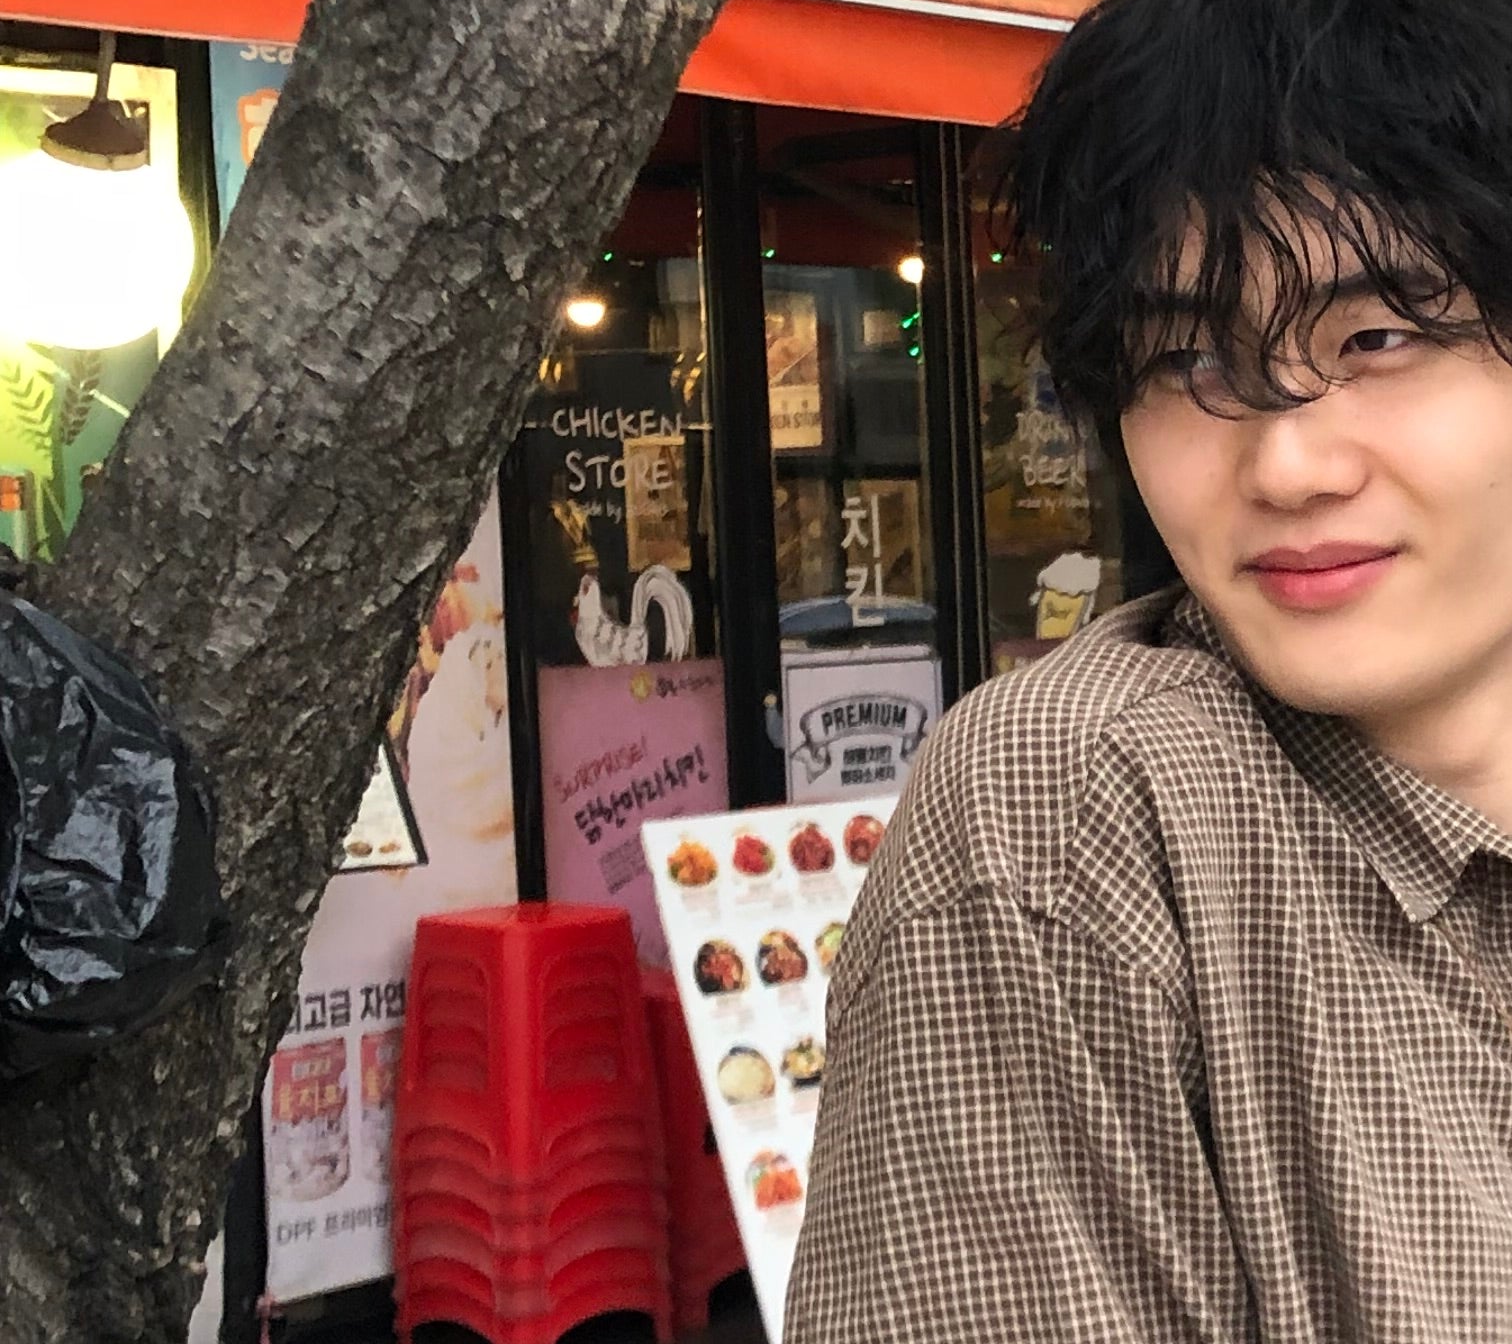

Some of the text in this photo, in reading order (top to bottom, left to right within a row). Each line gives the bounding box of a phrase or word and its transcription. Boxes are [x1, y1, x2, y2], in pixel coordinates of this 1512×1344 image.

[552, 406, 683, 443] CHICKEN
[565, 449, 674, 493] STORE
[840, 493, 885, 627] 치킨
[821, 703, 907, 736] PREMIUM
